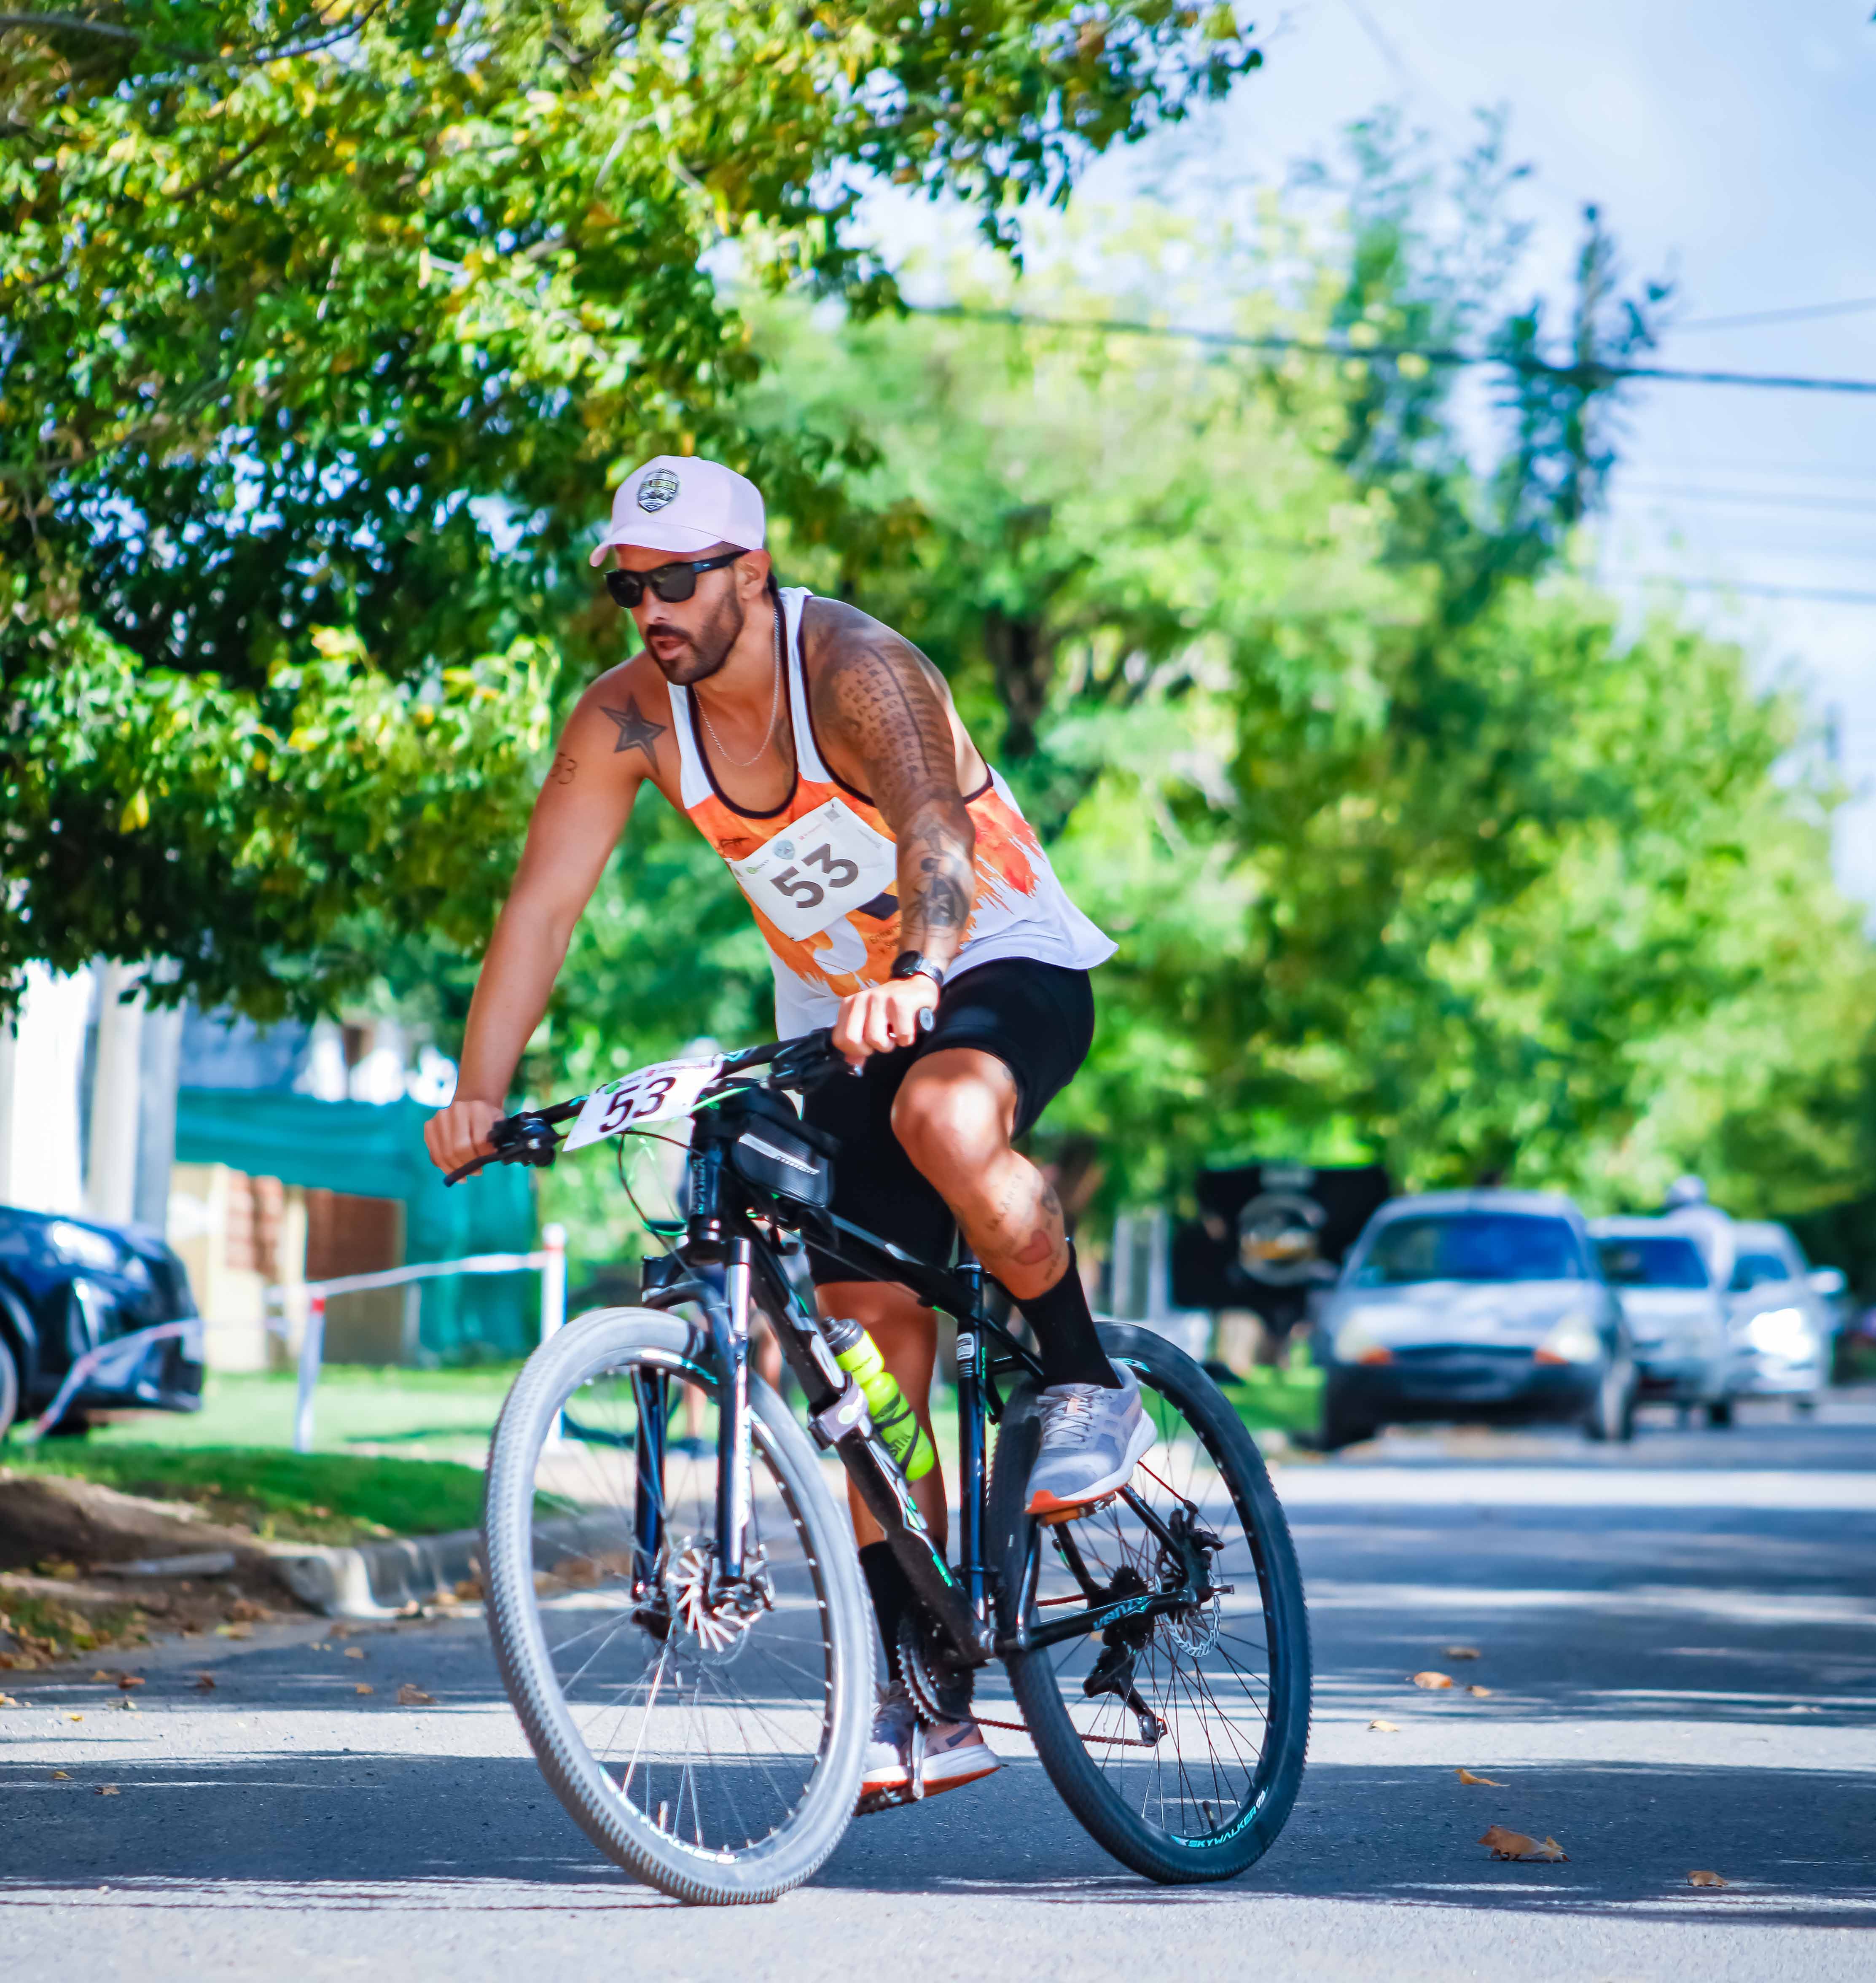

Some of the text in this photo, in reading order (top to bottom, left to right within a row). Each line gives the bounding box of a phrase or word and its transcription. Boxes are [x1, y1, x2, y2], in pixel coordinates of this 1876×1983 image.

[769, 843, 859, 908] 53
[600, 1077, 676, 1133] 53
[1188, 1805, 1257, 1848] SKYWALKER
